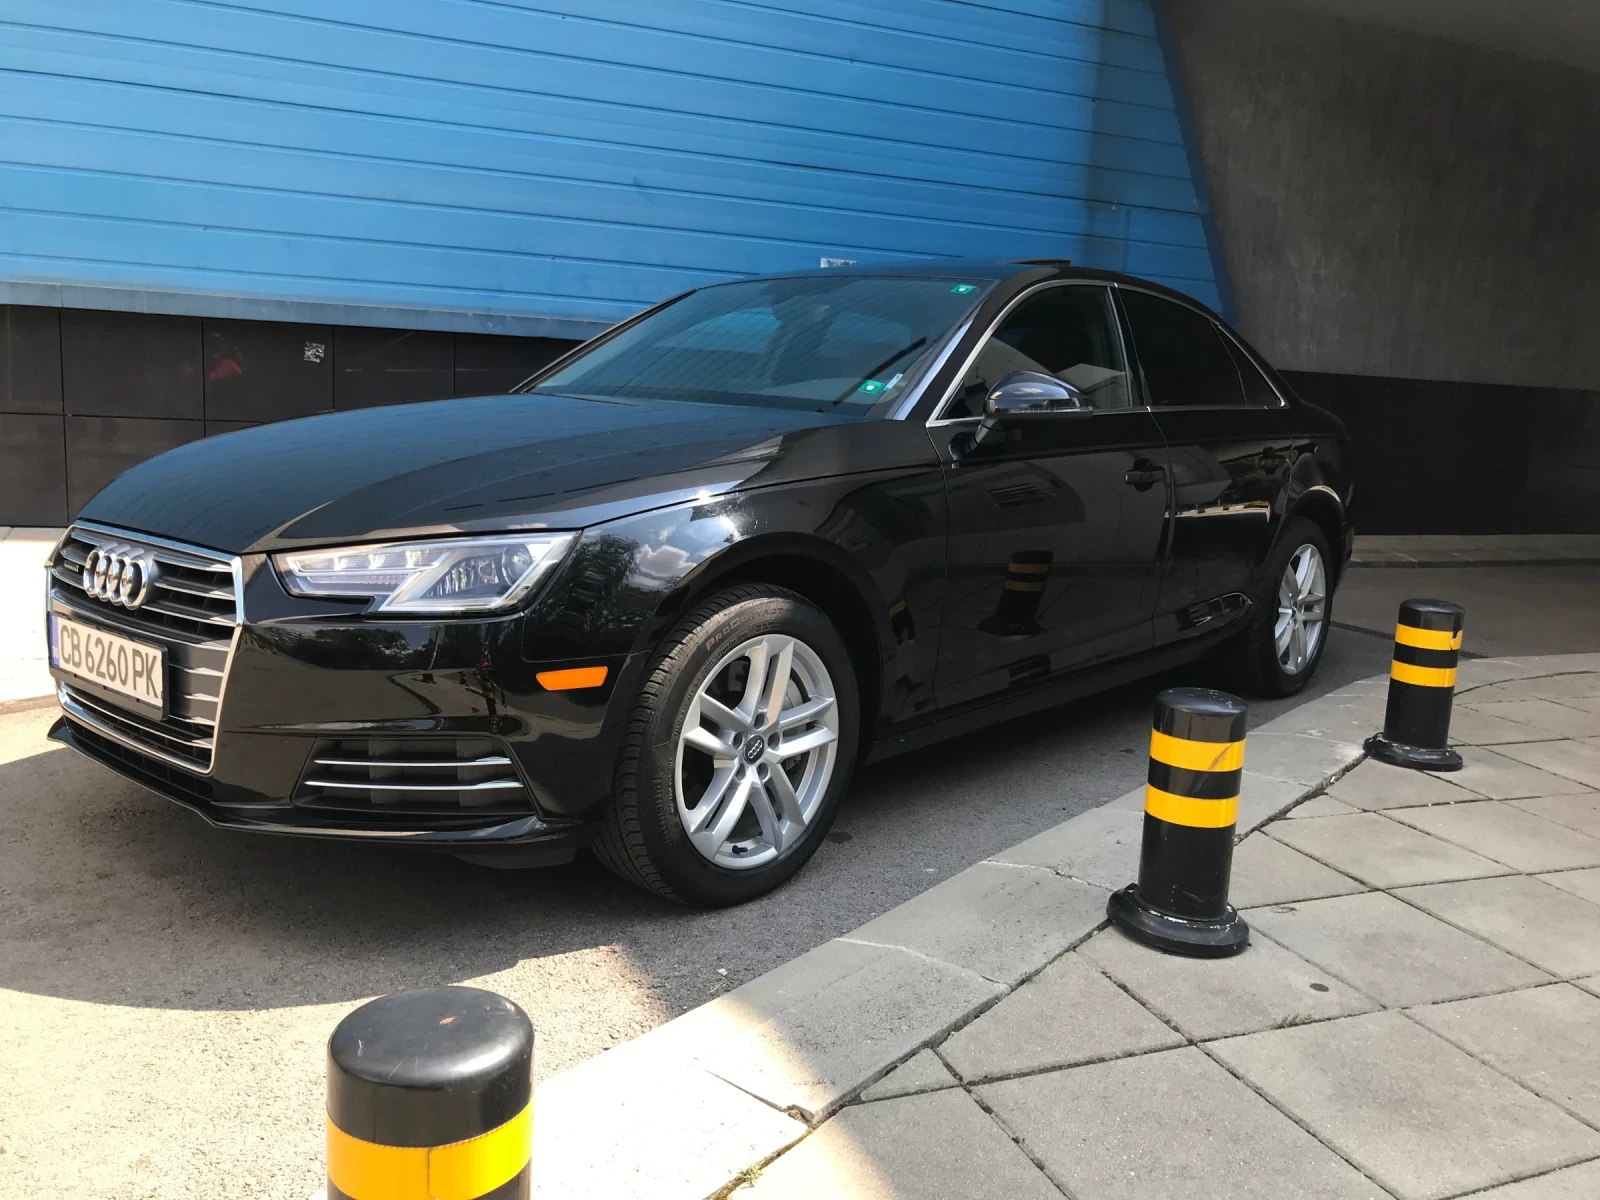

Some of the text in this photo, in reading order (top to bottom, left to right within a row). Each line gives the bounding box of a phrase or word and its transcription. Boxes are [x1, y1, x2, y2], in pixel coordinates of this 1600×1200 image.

[60, 625, 159, 699] CB 6260 PK
